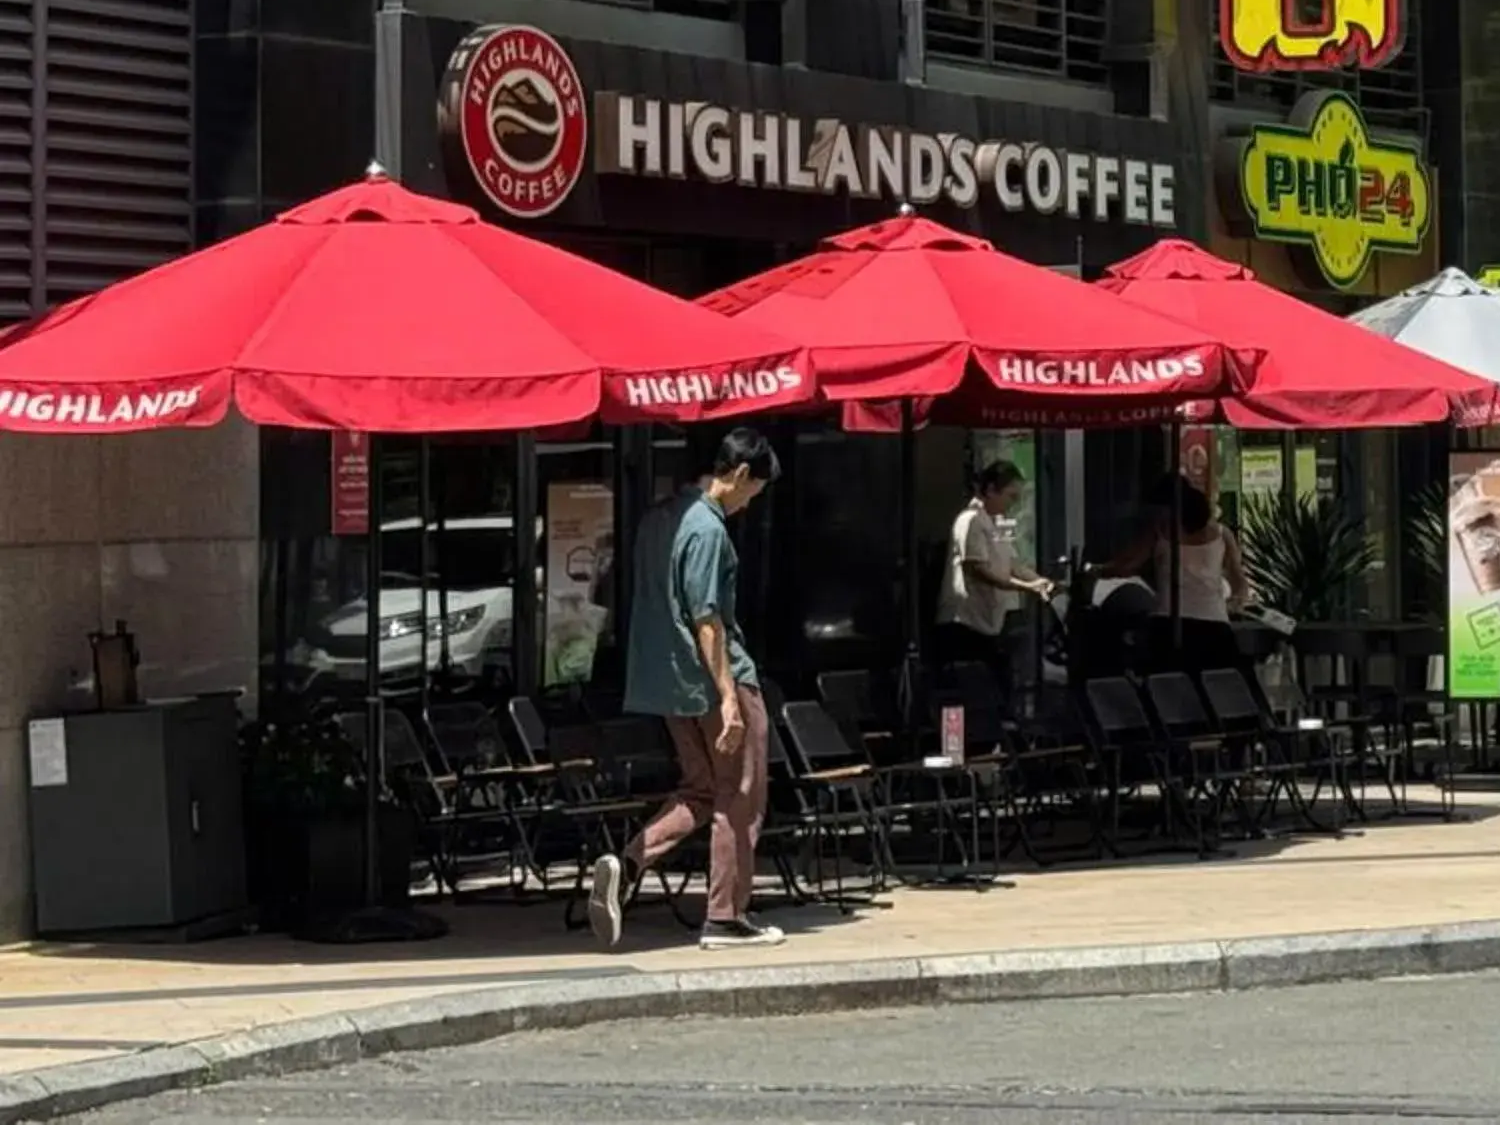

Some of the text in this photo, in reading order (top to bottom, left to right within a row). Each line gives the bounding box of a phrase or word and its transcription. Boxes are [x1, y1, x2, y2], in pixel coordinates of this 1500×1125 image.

[469, 36, 580, 118] HIGHLANDS
[484, 158, 568, 204] COFFEE
[618, 95, 1176, 223] HIGHLANDS COFFEE
[625, 365, 802, 407] HIGHLANDS
[999, 354, 1204, 386] HIGHLANDS
